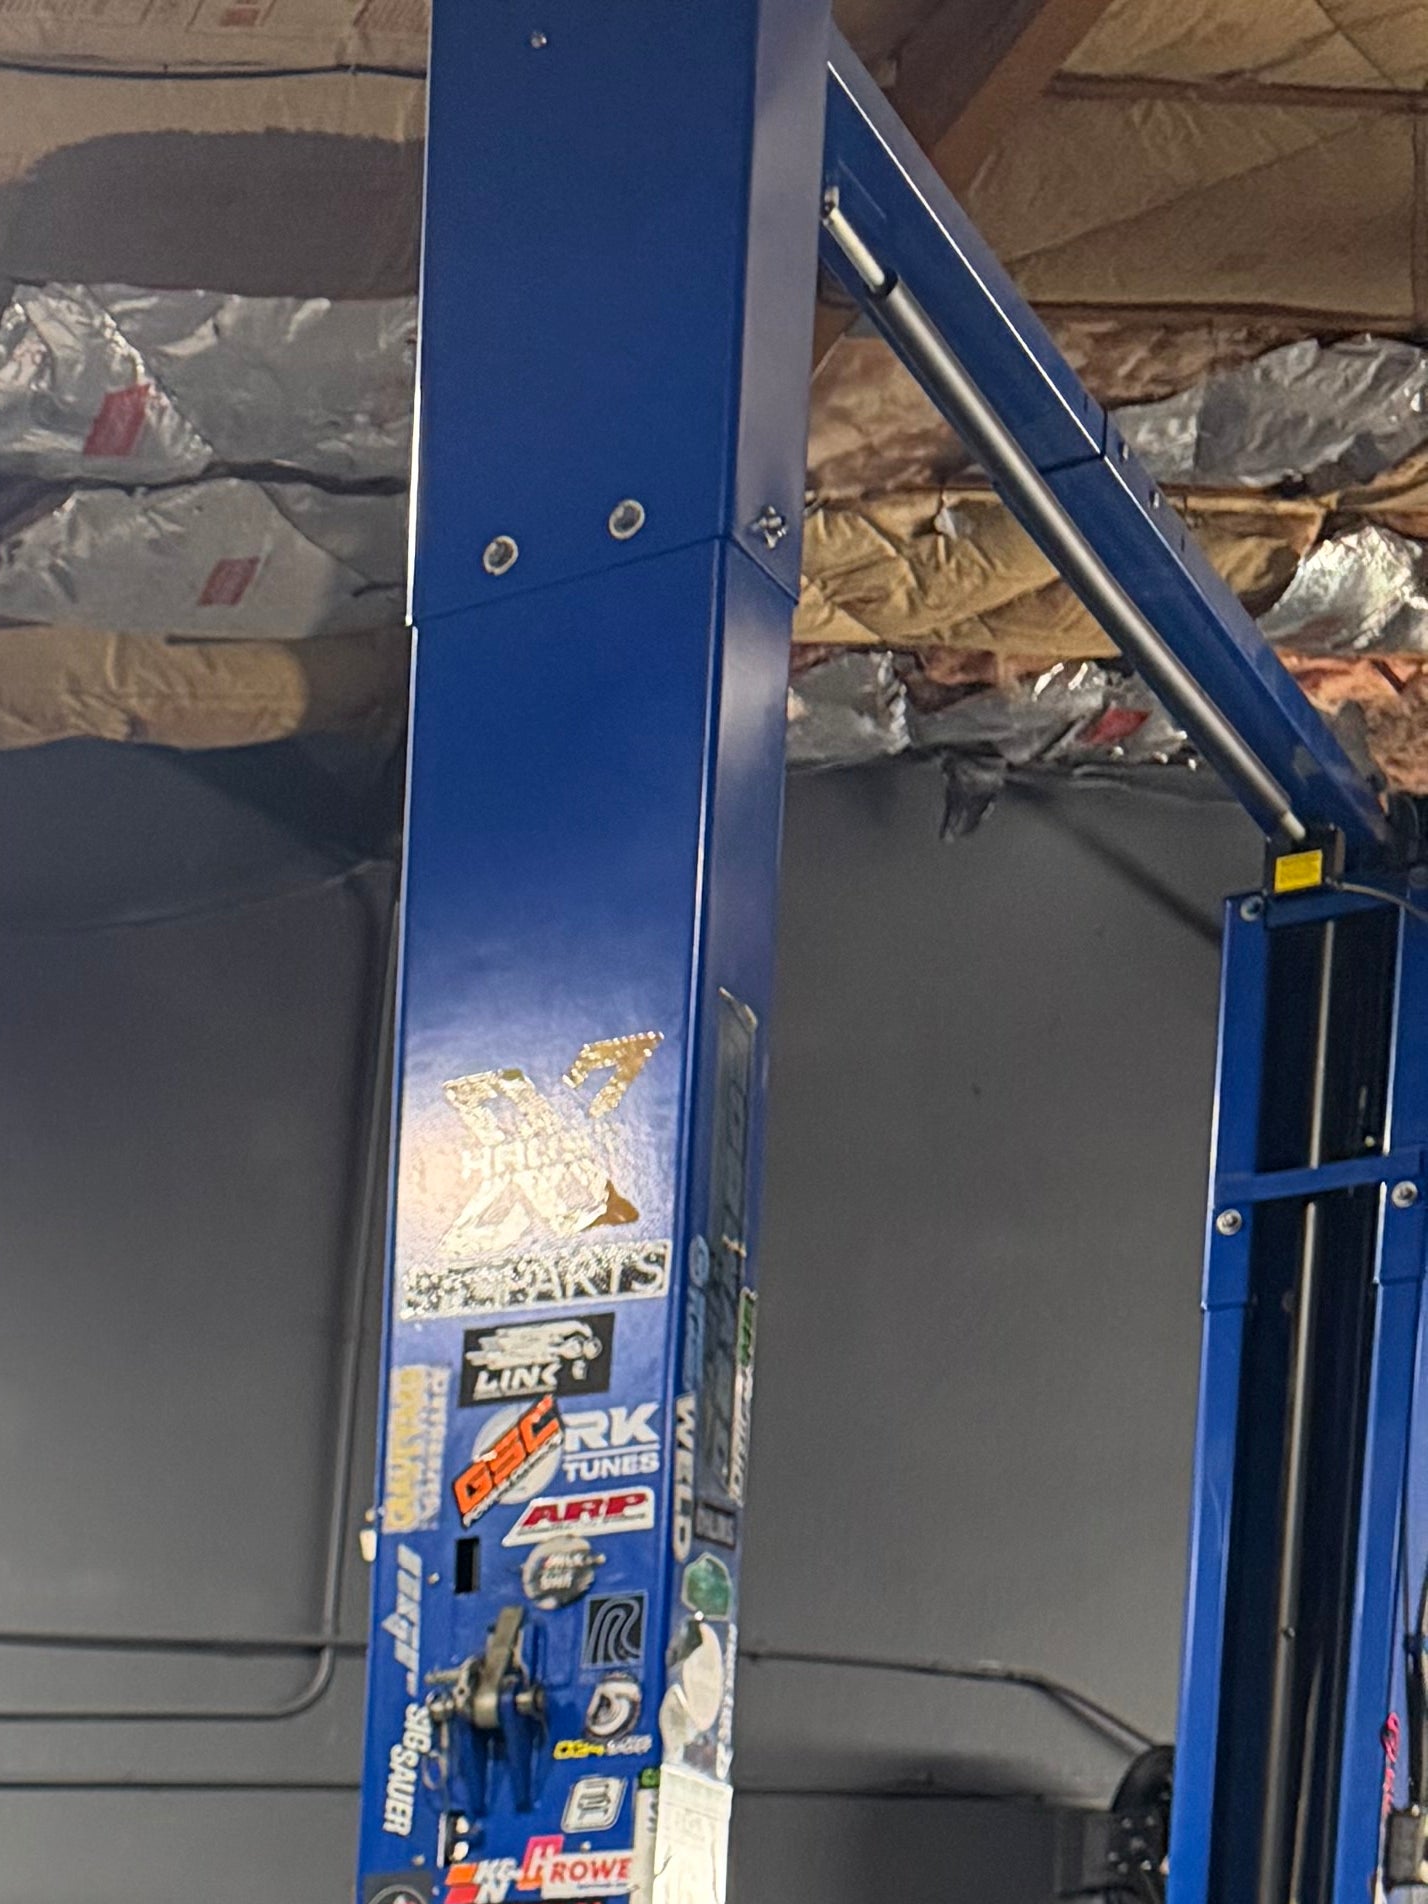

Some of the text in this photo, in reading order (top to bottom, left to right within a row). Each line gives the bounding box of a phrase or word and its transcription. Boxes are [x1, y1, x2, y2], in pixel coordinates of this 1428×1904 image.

[454, 1394, 560, 1517] GSC
[563, 1452, 660, 1483] TUNES
[520, 1493, 648, 1528] ARP
[406, 1702, 433, 1753] SIG
[382, 1744, 419, 1838] SAUER
[550, 1857, 632, 1884] ROWE
